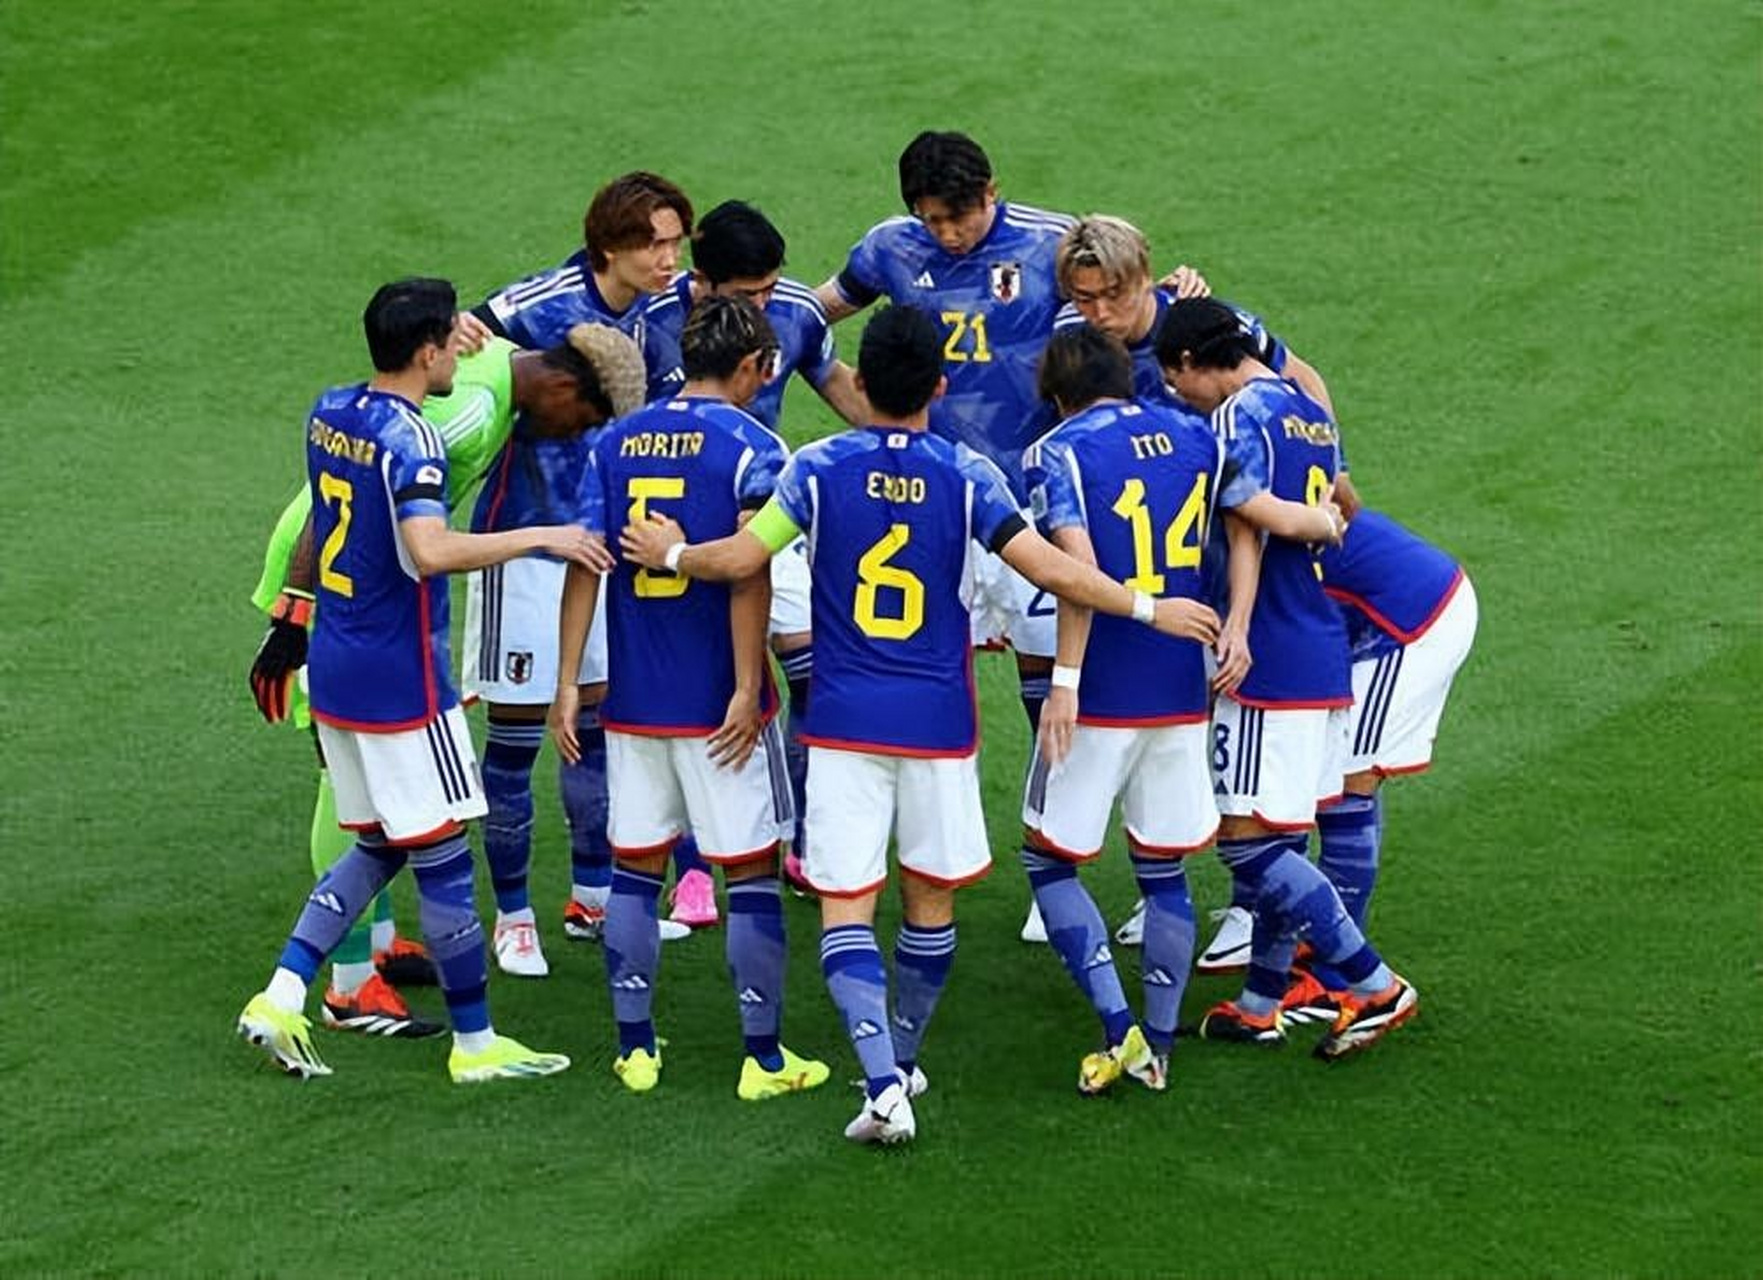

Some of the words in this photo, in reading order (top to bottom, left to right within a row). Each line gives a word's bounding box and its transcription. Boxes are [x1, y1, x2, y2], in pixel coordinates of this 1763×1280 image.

[941, 311, 992, 362] 21
[1130, 433, 1174, 459] ITO
[319, 471, 354, 598] 2
[628, 478, 690, 598] 5
[853, 523, 925, 640] 6
[1112, 472, 1208, 594] 14
[1213, 723, 1230, 772] 8
